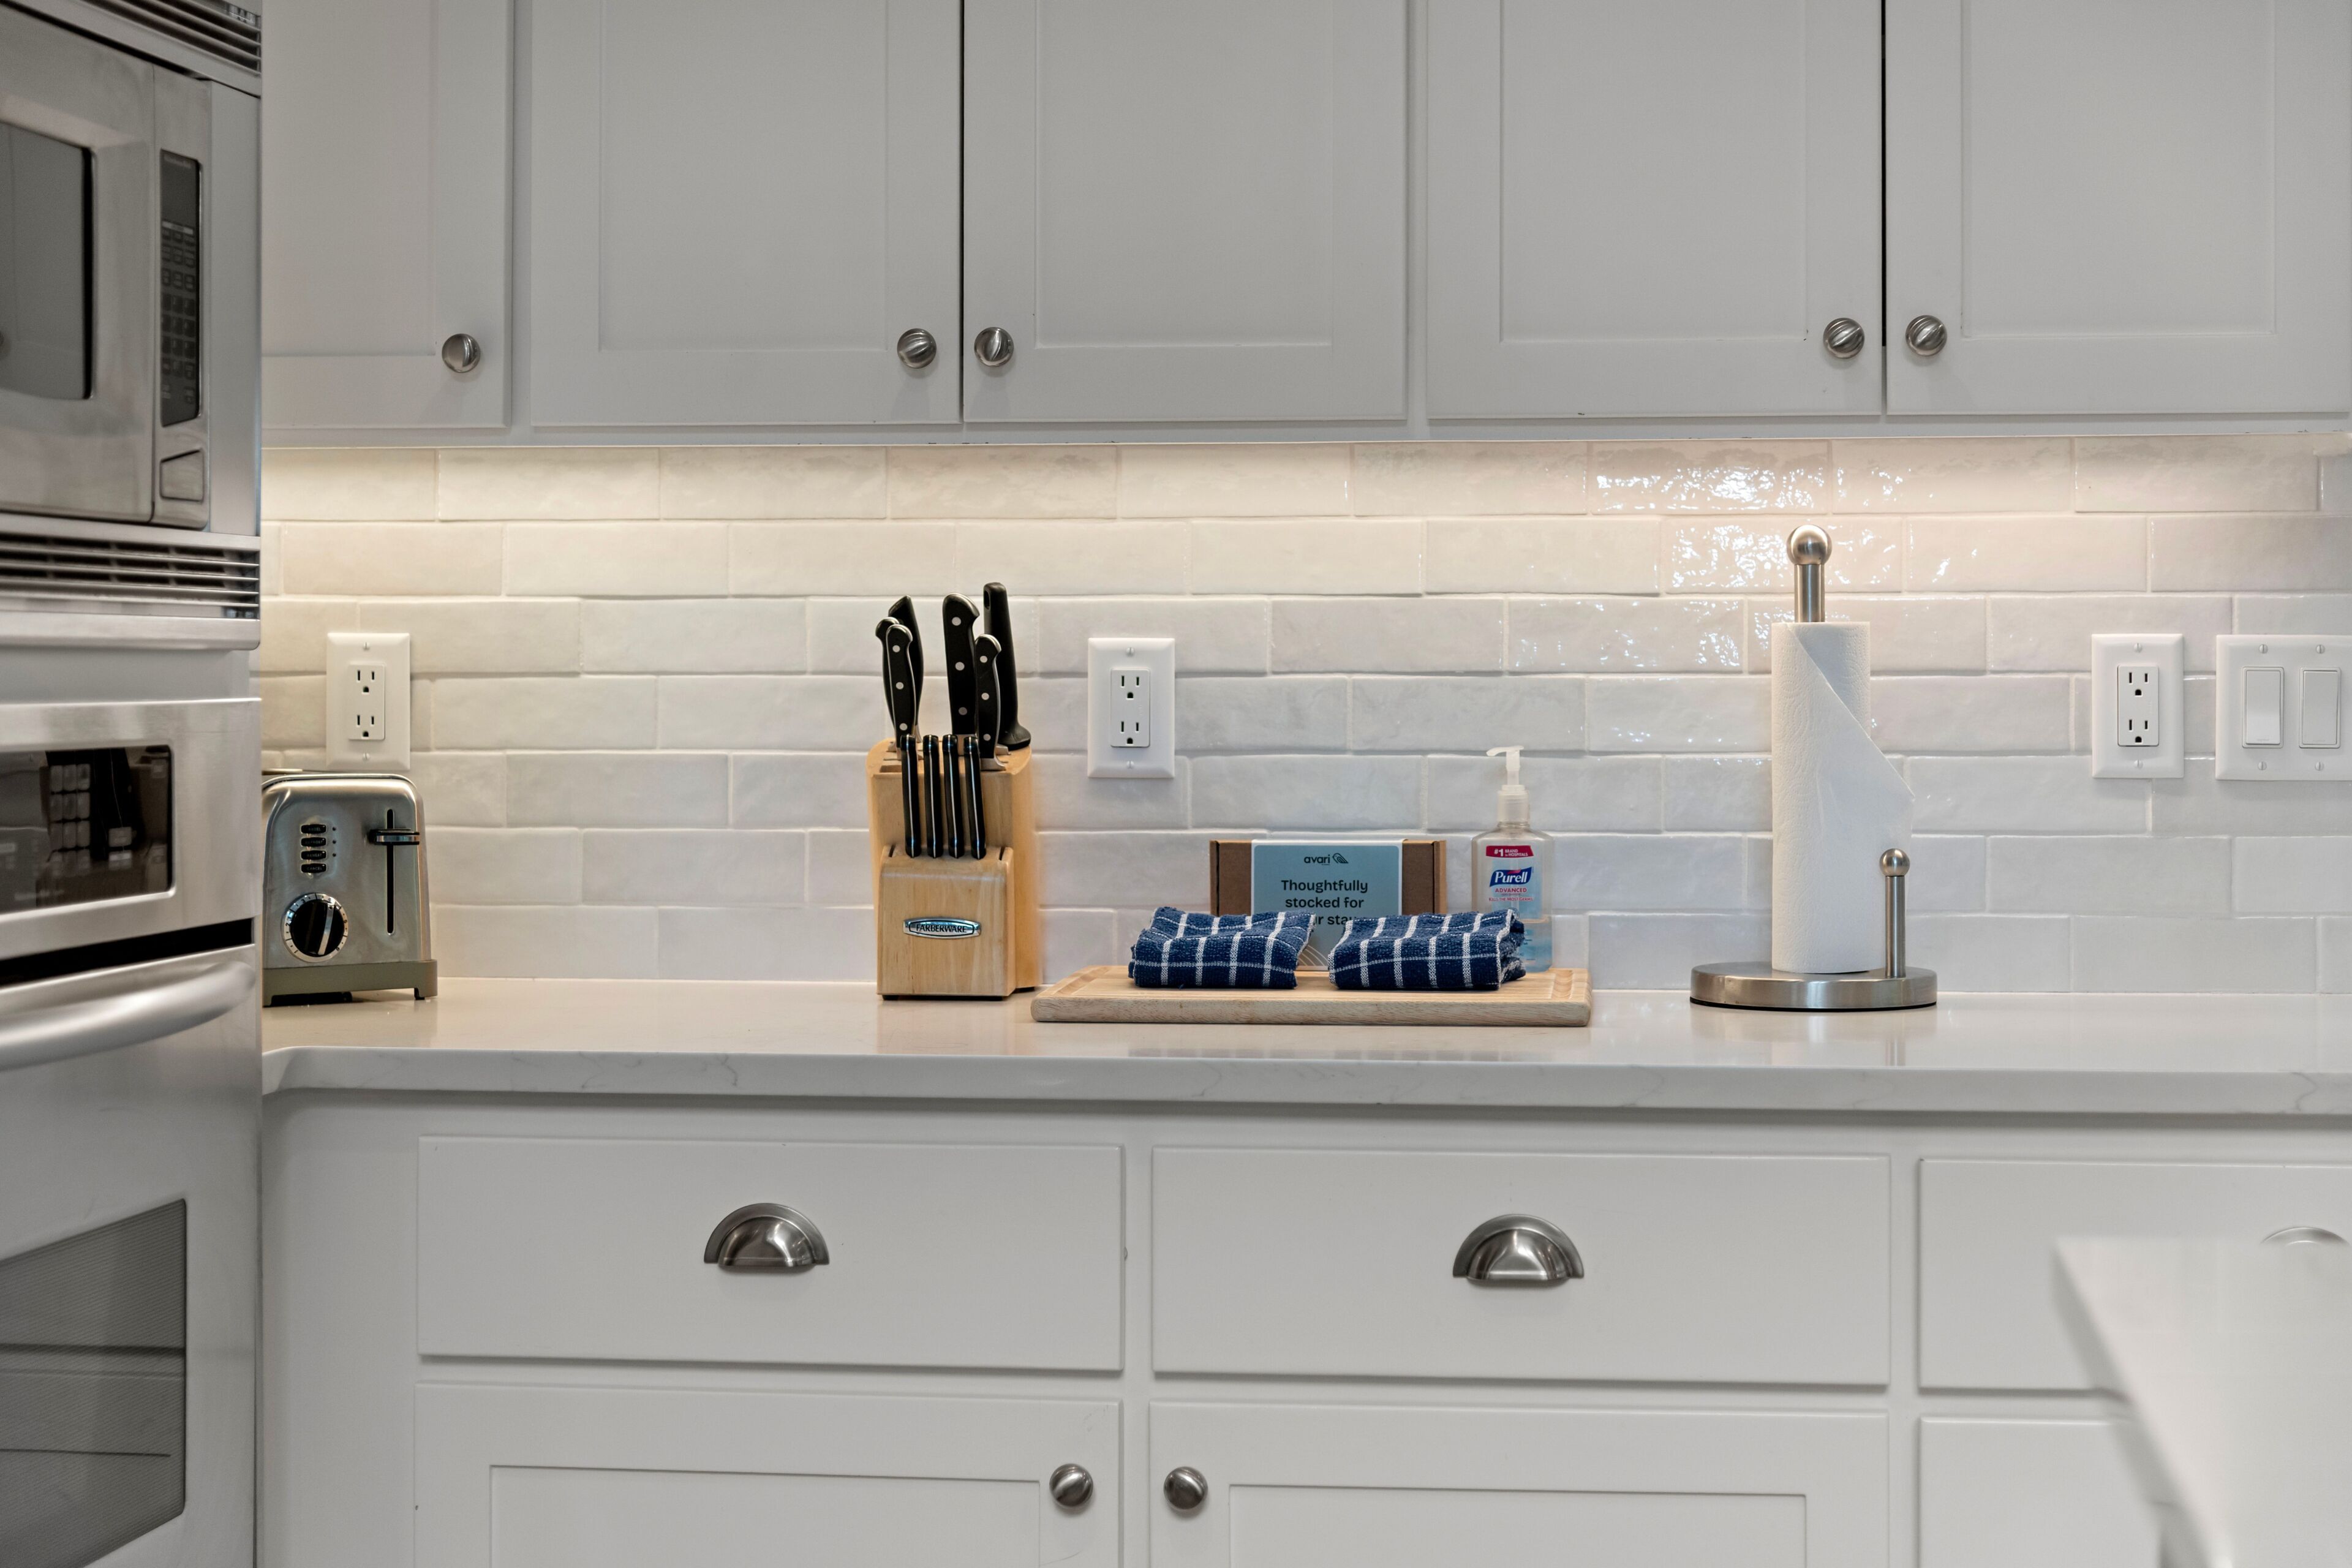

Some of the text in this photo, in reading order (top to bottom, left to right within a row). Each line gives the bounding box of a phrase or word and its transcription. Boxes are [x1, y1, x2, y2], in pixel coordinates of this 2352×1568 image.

[1494, 848, 1504, 857] #1
[1304, 854, 1330, 864] avari
[1494, 871, 1528, 883] Purell
[1281, 880, 1368, 894] Thoughtfully
[1285, 897, 1365, 908] stocked for
[916, 924, 967, 933] FARBERWARE
